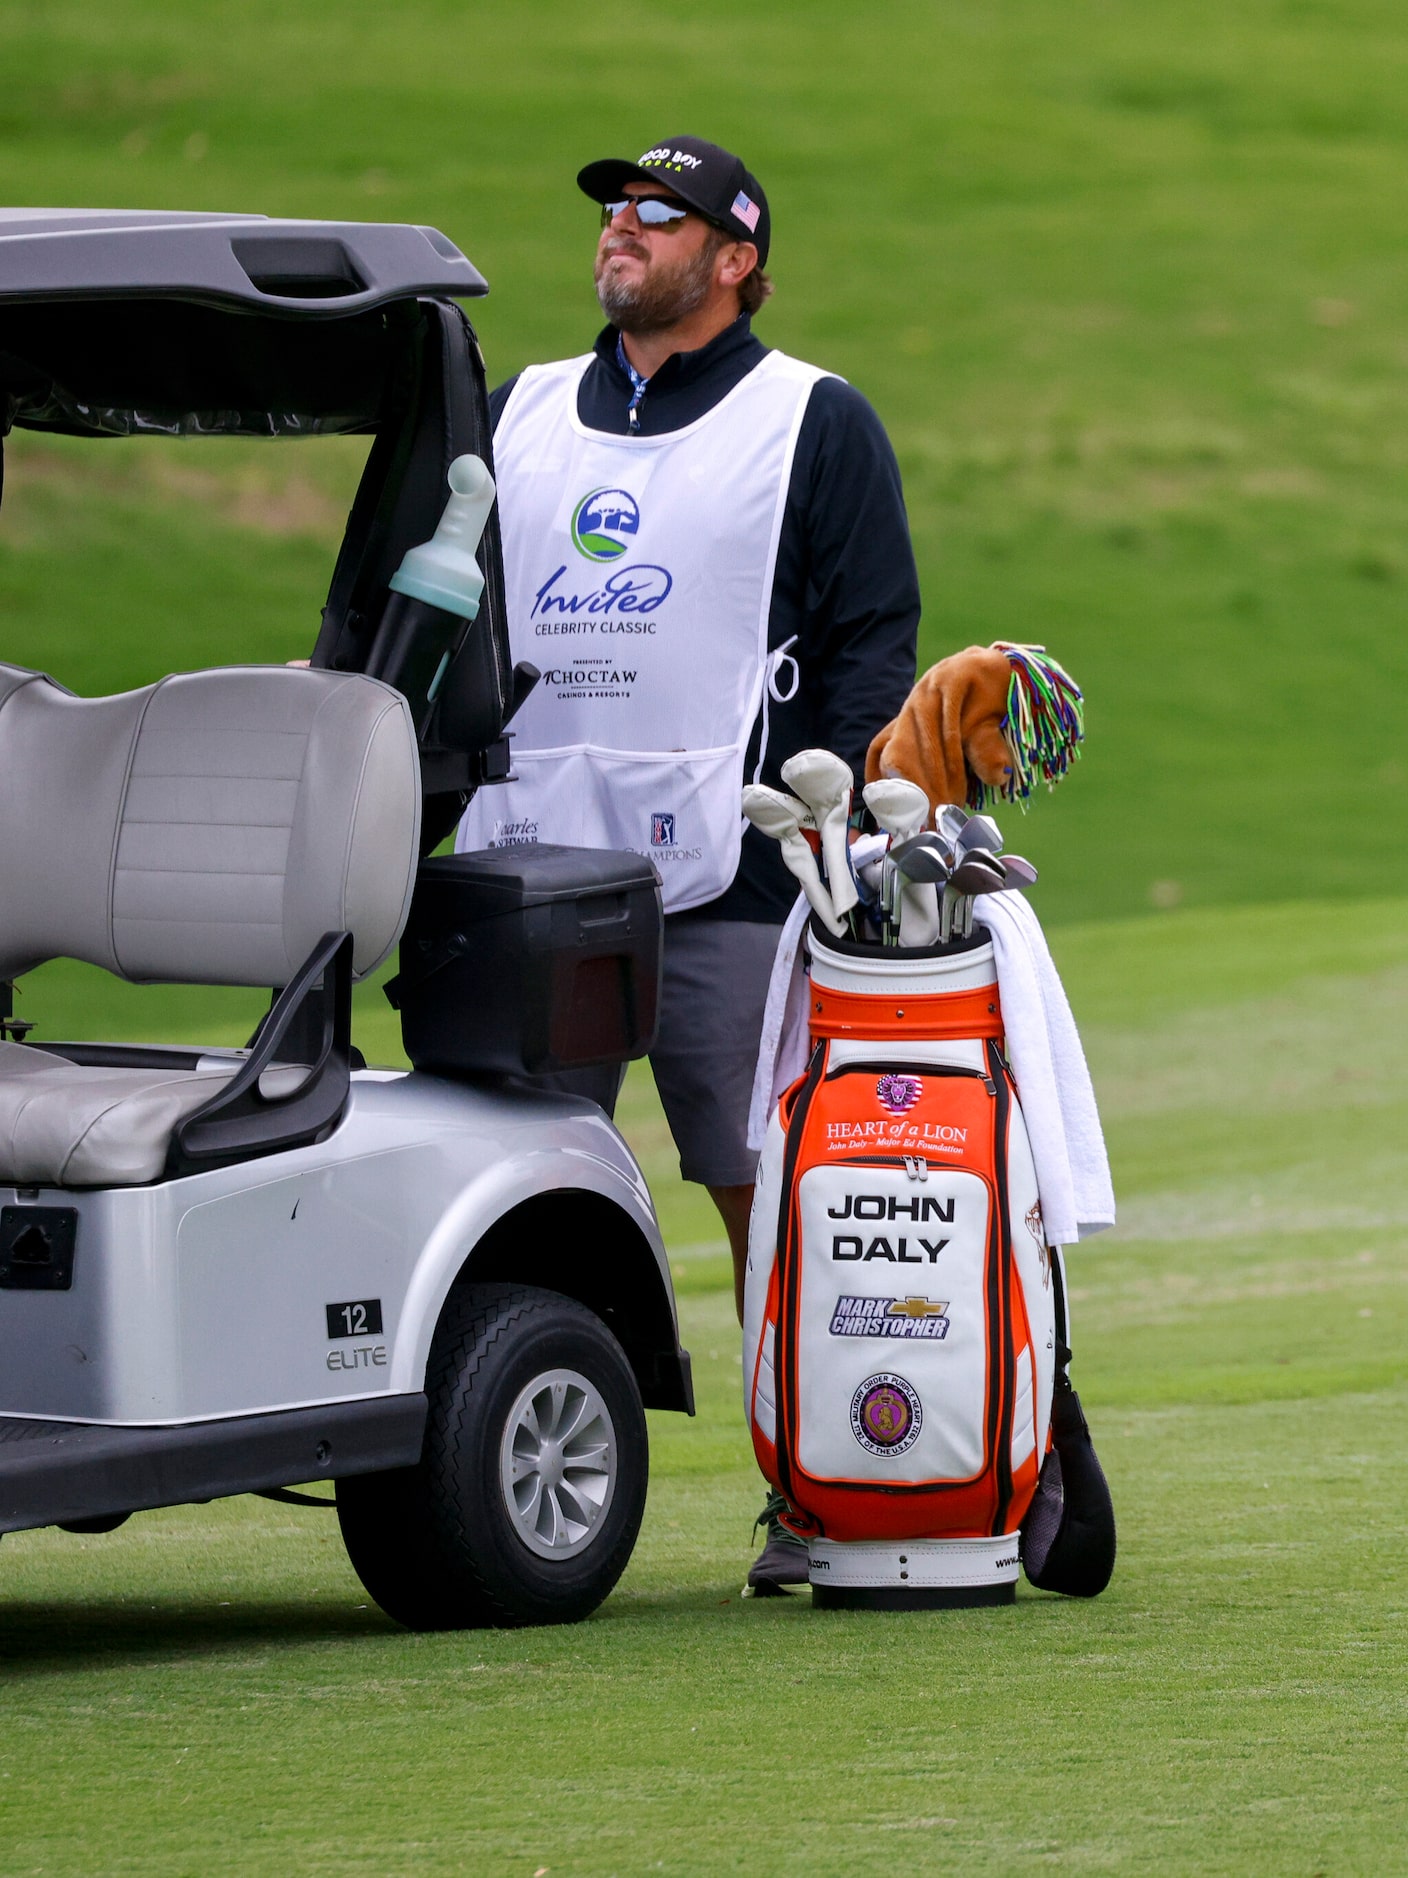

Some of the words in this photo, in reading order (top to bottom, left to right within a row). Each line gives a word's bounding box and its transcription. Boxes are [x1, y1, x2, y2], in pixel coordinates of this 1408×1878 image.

[671, 150, 703, 170] BOY
[530, 564, 673, 620] Invited
[535, 622, 597, 636] CELEBRITY
[600, 621, 657, 635] CLASSIC
[550, 669, 638, 685] CHOCTAW
[557, 691, 586, 699] CASINOS
[595, 690, 630, 699] RESORTS
[827, 1121, 888, 1138] HEART
[889, 1121, 909, 1137] of
[908, 1125, 918, 1135] a
[923, 1123, 968, 1142] LION
[827, 1142, 847, 1151] John
[848, 1139, 867, 1149] Daly
[876, 1138, 900, 1147] Major
[903, 1138, 915, 1147] Ed
[917, 1140, 964, 1154] Foundation
[827, 1195, 955, 1223] JOHN
[832, 1236, 950, 1264] DALY
[837, 1298, 889, 1318] MARK
[341, 1304, 368, 1335] 12
[831, 1316, 947, 1338] CHRISTOPHER
[852, 1389, 865, 1422] MILITARY
[863, 1375, 889, 1390] ORDER
[891, 1377, 915, 1399] PURPLE
[911, 1399, 921, 1424] HEART
[854, 1424, 865, 1440] 1782
[864, 1440, 875, 1450] OF
[876, 1447, 891, 1455] THE
